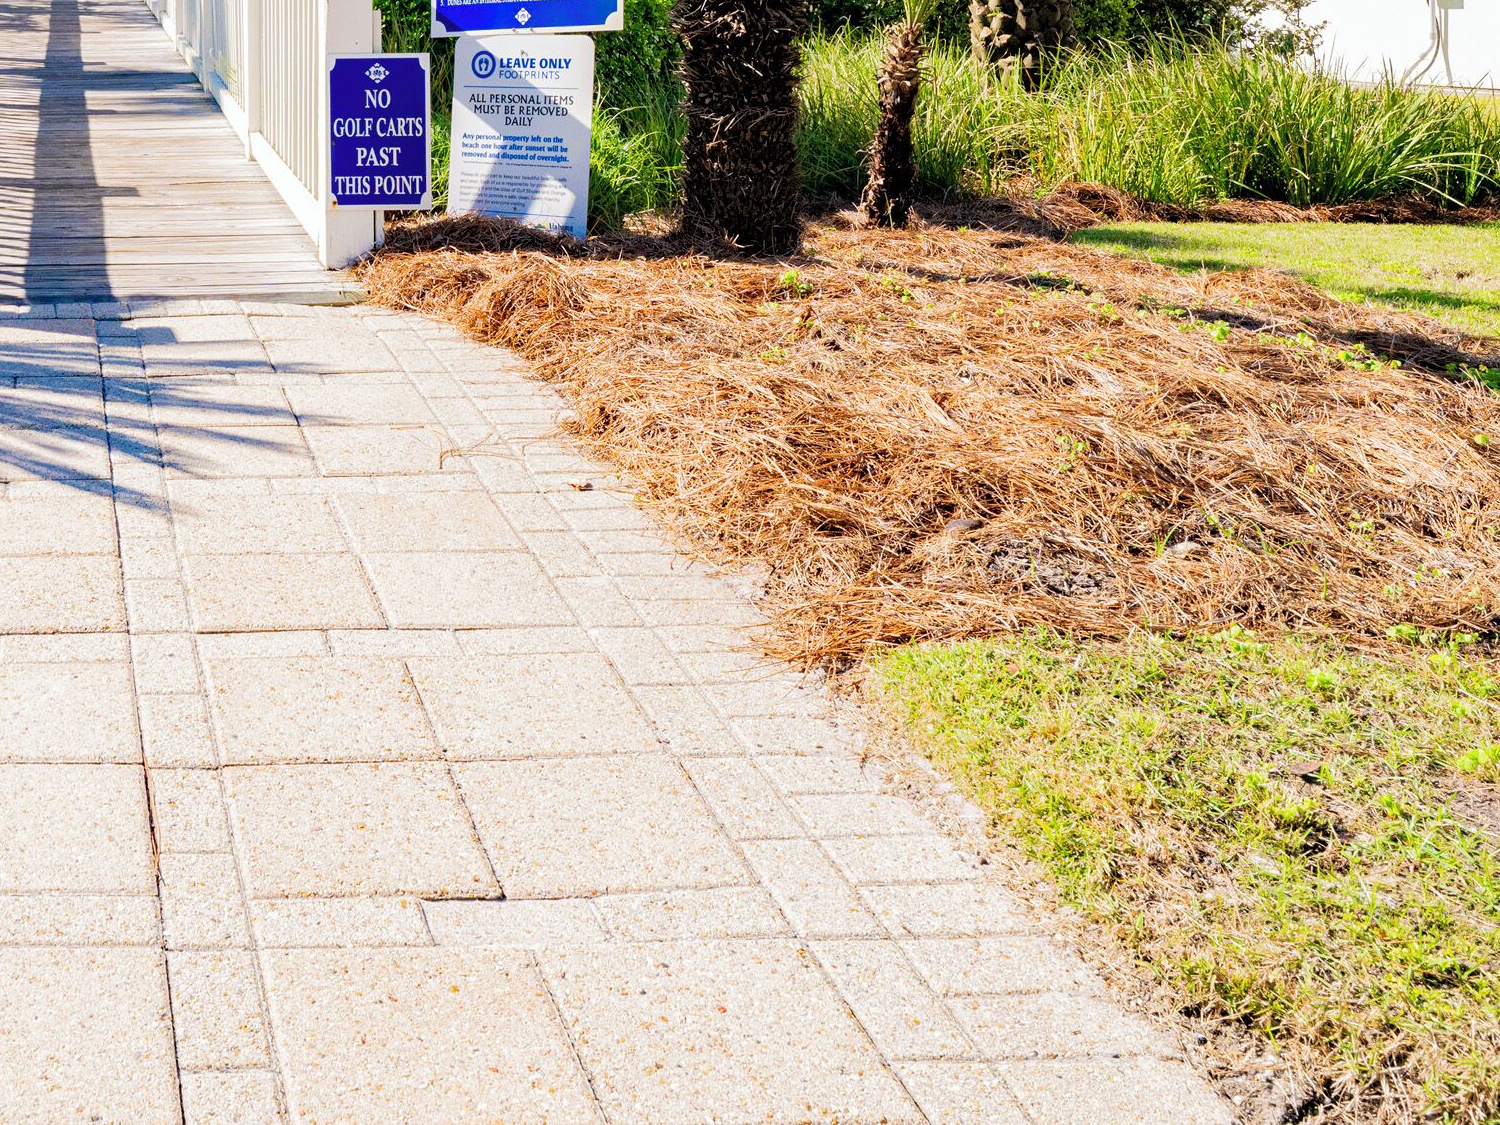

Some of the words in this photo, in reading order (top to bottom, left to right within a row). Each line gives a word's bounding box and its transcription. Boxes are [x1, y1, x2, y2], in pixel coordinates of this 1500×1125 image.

[500, 58, 536, 68] LEAVE
[540, 58, 572, 69] ONLY
[499, 70, 560, 80] FOOTPRINTS
[364, 89, 391, 108] NO
[469, 94, 486, 103] ALL
[490, 94, 542, 104] PERSONAL
[544, 95, 574, 105] ITEMS
[474, 104, 500, 114] MUST
[504, 106, 515, 115] BE
[520, 106, 568, 116] REMOVED
[505, 116, 533, 126] DAILY
[333, 118, 373, 138] GOLF
[376, 117, 423, 137] CARTS
[503, 135, 529, 143] property
[356, 147, 401, 166] PAST
[537, 154, 569, 163] overnight.
[334, 176, 370, 195] THIS
[374, 176, 422, 195] POINT
